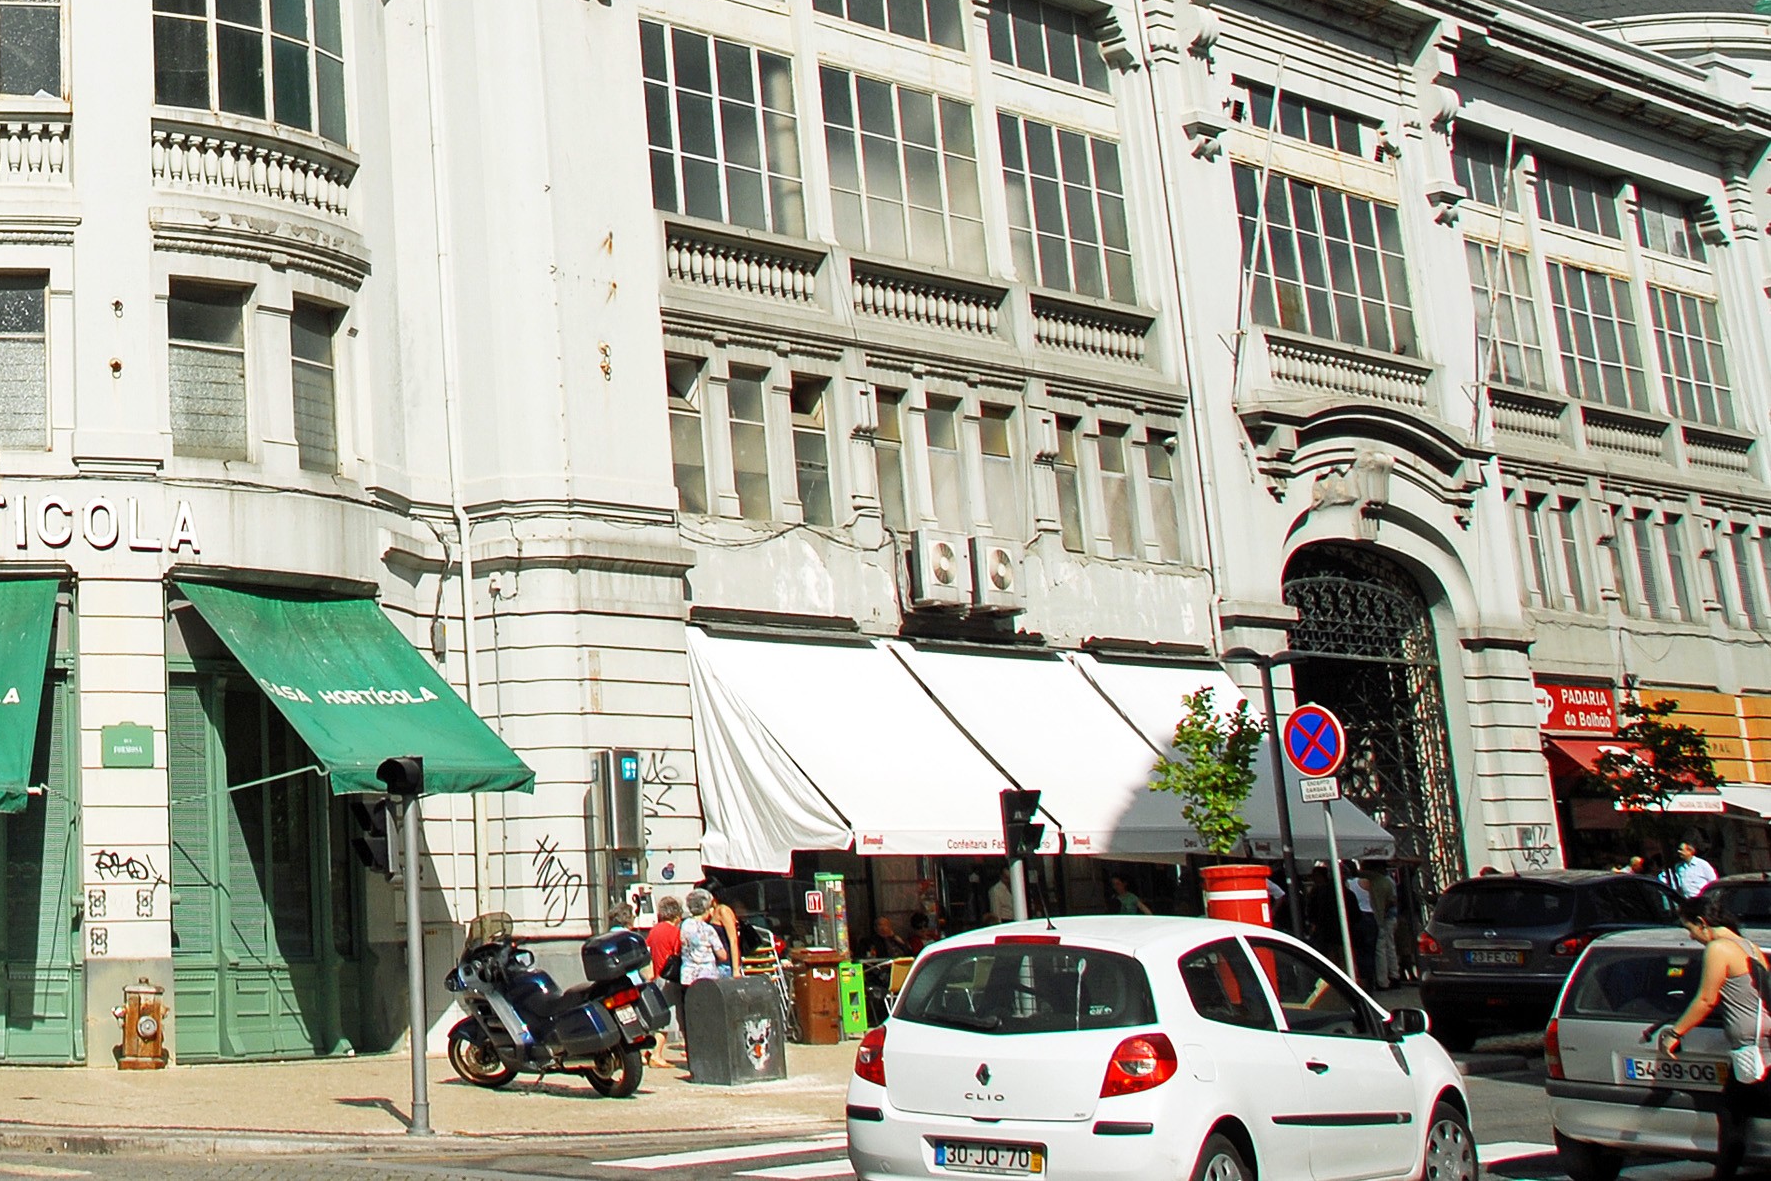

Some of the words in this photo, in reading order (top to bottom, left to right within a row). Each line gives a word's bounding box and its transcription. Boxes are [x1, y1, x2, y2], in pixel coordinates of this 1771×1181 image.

[260, 678, 313, 704] CASA
[318, 686, 439, 705] HORTÍCOLA
[1560, 688, 1608, 707] PADARIA
[1564, 710, 1577, 727] do
[1578, 711, 1612, 728] Bolhão
[947, 838, 988, 850] Confeitaria
[964, 1092, 1005, 1102] CLIO
